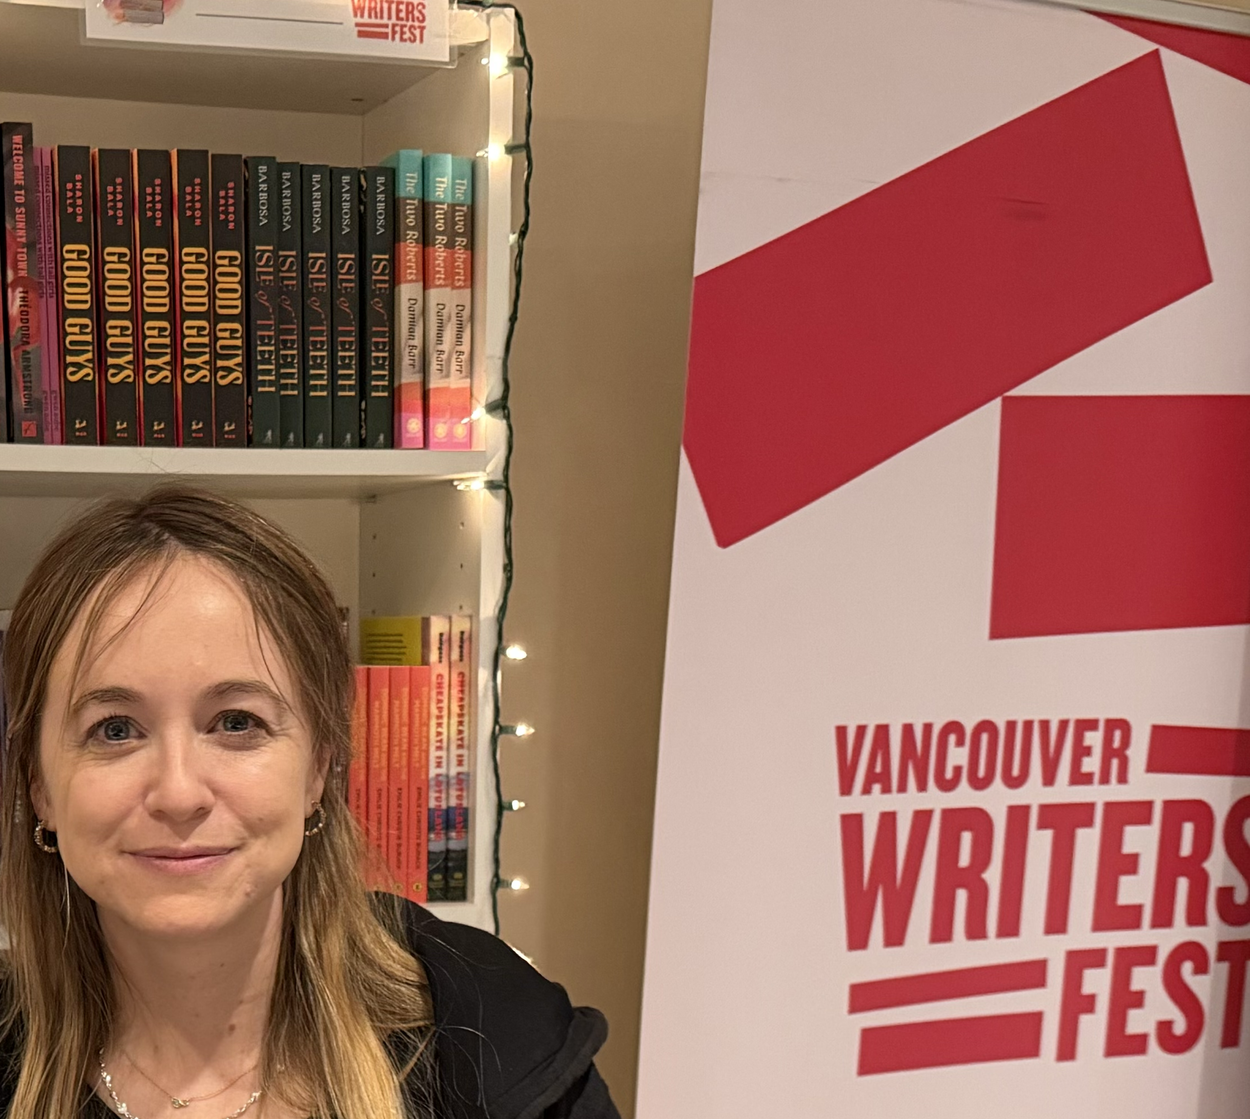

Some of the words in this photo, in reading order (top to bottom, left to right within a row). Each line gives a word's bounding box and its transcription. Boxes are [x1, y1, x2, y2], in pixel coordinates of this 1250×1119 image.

[351, 0, 426, 24] WRITERS
[391, 23, 426, 44] FEST
[75, 174, 83, 222] SHARON
[258, 165, 268, 226] BARBOSA
[435, 177, 447, 199] The
[435, 203, 447, 232] Two
[62, 244, 91, 310] GOOD
[255, 245, 274, 286] ISLE
[435, 234, 447, 286] Roberts
[65, 317, 94, 382] GUYS
[436, 303, 446, 346] Damian
[257, 320, 276, 392] TEETH
[435, 349, 444, 373] Barr
[436, 673, 444, 751] CHEAPSKATE
[435, 755, 443, 768] IN
[835, 718, 1131, 796] VANCOUVER
[840, 794, 1250, 952] WRITERS
[1055, 939, 1250, 1062] FEST
